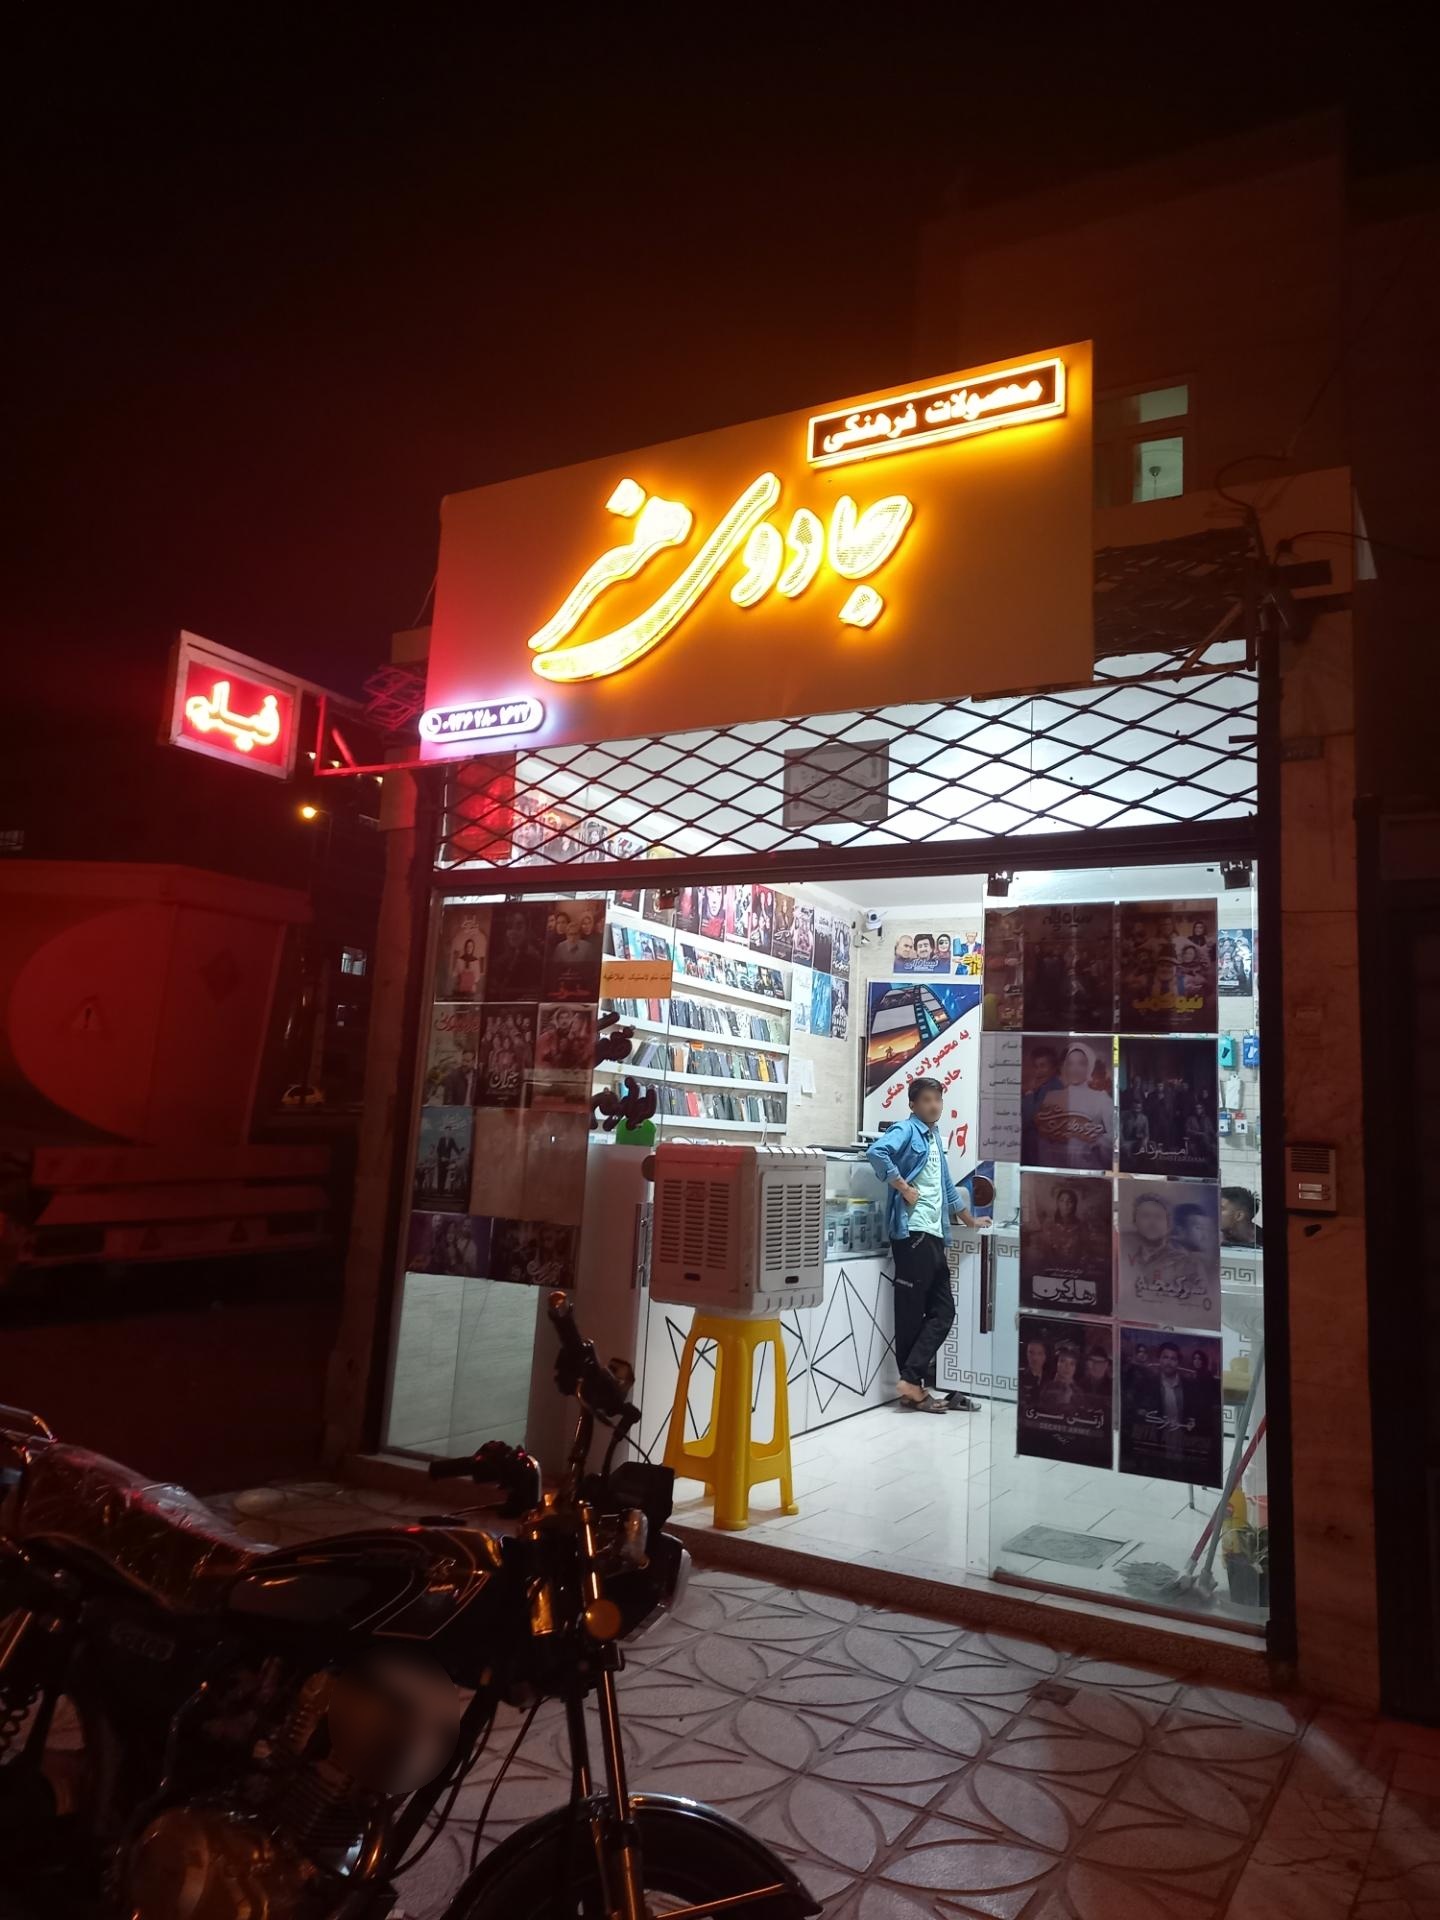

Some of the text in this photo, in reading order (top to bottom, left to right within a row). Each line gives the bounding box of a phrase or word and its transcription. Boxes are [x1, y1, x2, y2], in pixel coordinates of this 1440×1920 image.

[822, 379, 1043, 453] محصولات فرهنگی
[186, 681, 280, 752] فیلم
[1132, 1136, 1190, 1160] آمستردام
[1025, 1407, 1065, 1420] سری
